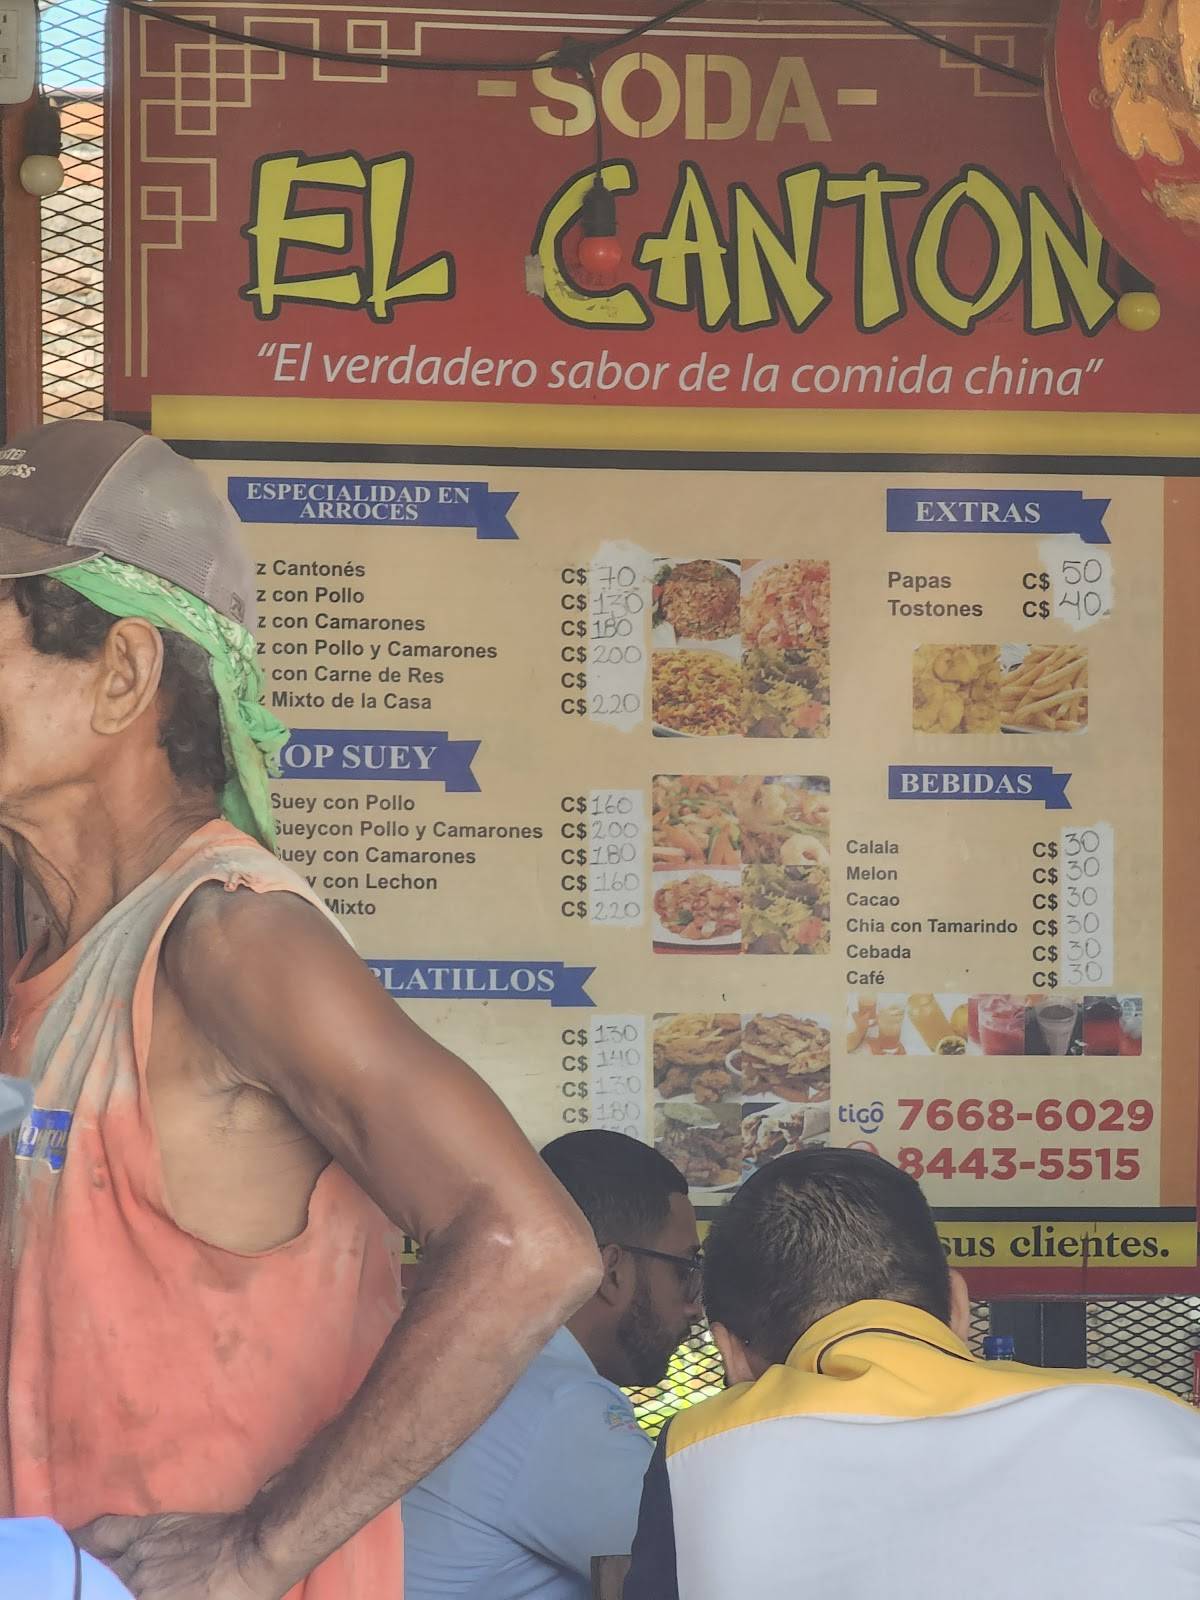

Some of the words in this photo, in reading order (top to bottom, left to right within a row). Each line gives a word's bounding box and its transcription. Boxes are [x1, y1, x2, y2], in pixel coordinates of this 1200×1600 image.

[240, 151, 455, 324] EL
[533, 158, 1118, 334] CANTON
[323, 345, 538, 389] verdadero
[548, 351, 670, 391] sabor
[679, 354, 730, 392] de
[741, 355, 778, 392] la
[791, 355, 951, 396] comida
[246, 482, 431, 504] ESPECIALIDAD
[438, 487, 471, 504] EN
[299, 502, 419, 521] ARROCES
[915, 500, 1041, 524] EXTRAS
[272, 560, 366, 577] Cantonés
[561, 568, 587, 585] C$
[598, 566, 636, 590] 70
[1022, 572, 1050, 590] C$
[1062, 558, 1102, 585] 50
[888, 571, 952, 592] Papas
[272, 590, 308, 603] con
[315, 587, 365, 604] Pollo
[561, 594, 587, 612] C$
[1022, 600, 1050, 618] C$
[1059, 591, 1102, 620] 40
[888, 599, 983, 617] Tostones
[272, 616, 308, 629] con
[315, 613, 426, 631] Camarones
[561, 620, 587, 638] C$
[272, 642, 308, 655] con
[315, 639, 364, 656] Pollo
[370, 644, 381, 660] y
[388, 640, 498, 659] Camarones
[561, 646, 587, 664] C$
[592, 645, 642, 664] 200
[272, 668, 308, 681] con
[314, 665, 372, 682] Carne
[378, 667, 401, 683] de
[408, 667, 444, 684] Res
[561, 672, 587, 690] C$
[272, 691, 325, 708] Mixto
[331, 693, 354, 709] de
[361, 693, 377, 709] la
[384, 693, 432, 710] Casa
[561, 698, 587, 716] C$
[592, 693, 641, 715] 220
[278, 744, 334, 769] OP
[342, 745, 438, 770] SUEY
[900, 773, 1033, 795] BEBIDAS
[271, 792, 317, 813] Suey
[323, 798, 359, 810] con
[366, 794, 416, 811] Pollo
[561, 796, 587, 815] C$
[591, 794, 633, 816] 160
[360, 821, 409, 837] Pollo
[416, 825, 427, 841] y
[433, 822, 543, 840] Camarones
[561, 822, 587, 840] C$
[592, 820, 639, 840] 200
[561, 848, 587, 866] C$
[590, 843, 636, 865] 180
[846, 840, 899, 855] Calala
[1032, 842, 1058, 859] C$
[1065, 830, 1100, 857] 30
[323, 850, 359, 862] con
[365, 847, 476, 864] Camarones
[846, 866, 898, 881] Melon
[1032, 867, 1058, 885] C$
[1066, 856, 1100, 881] 30
[323, 876, 359, 889] con
[366, 873, 438, 890] Lechon
[561, 874, 587, 893] C$
[593, 872, 640, 892] 160
[324, 898, 376, 915] Mixto
[846, 892, 900, 907] Cacao
[1032, 893, 1058, 911] C$
[1066, 886, 1098, 908] 30
[561, 901, 587, 919] C$
[592, 902, 641, 920] 220
[846, 918, 885, 933] Chia
[890, 921, 922, 933] con
[927, 918, 1018, 934] Tamarindo
[1032, 919, 1058, 937] C$
[1066, 912, 1100, 935] 30
[846, 944, 912, 959] Cebada
[1032, 945, 1058, 963] C$
[1066, 938, 1101, 962] 30
[846, 970, 885, 985] Café
[1032, 971, 1058, 989] C$
[1067, 961, 1102, 985] 30
[562, 1029, 588, 1047] C$
[594, 1024, 638, 1044] 130
[562, 1055, 588, 1073] C$
[597, 1048, 641, 1068] 140
[562, 1081, 588, 1099] C$
[562, 1107, 588, 1125] C$
[897, 1098, 1154, 1132] 7668-6029
[897, 1147, 1141, 1181] 8443-5515
[1010, 1225, 1170, 1258] clientes.
